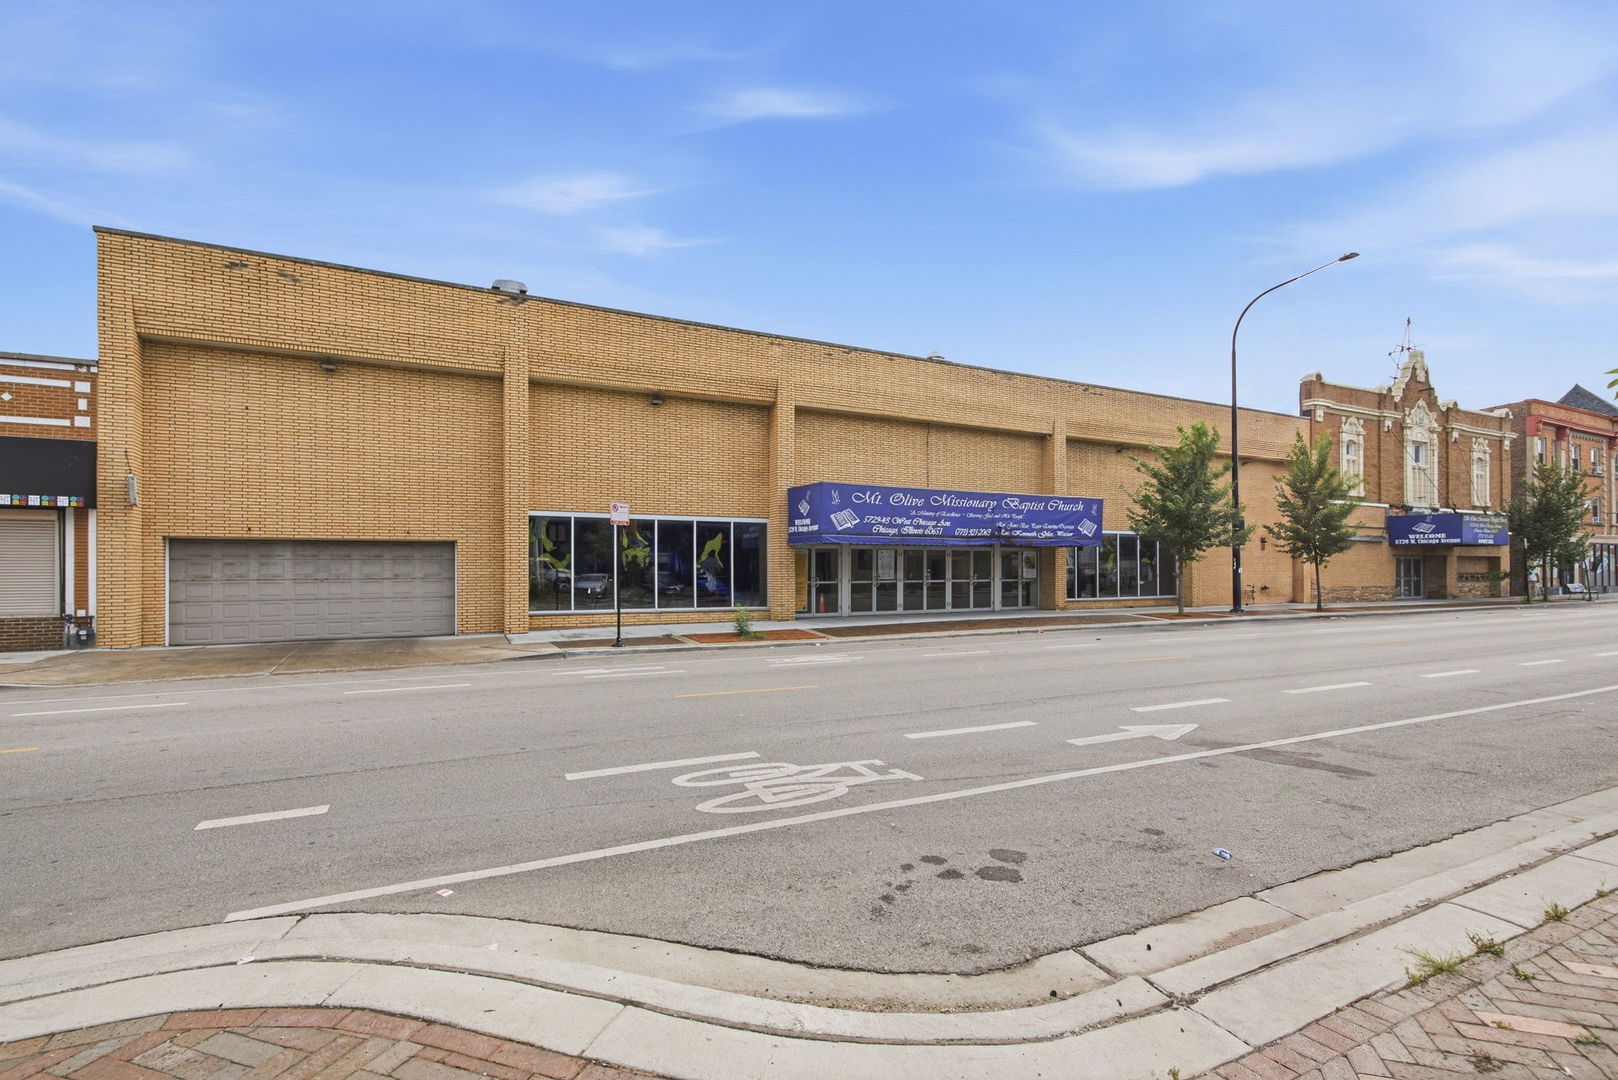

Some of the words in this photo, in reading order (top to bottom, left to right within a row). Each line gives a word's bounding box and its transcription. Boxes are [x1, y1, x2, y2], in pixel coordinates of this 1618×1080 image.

[852, 490, 883, 505] Mt.
[889, 492, 925, 507] Olive
[930, 493, 997, 512] Missionary
[1001, 496, 1045, 513] Baptist
[1047, 499, 1084, 512] Church
[891, 516, 912, 525] West
[912, 517, 937, 526] Chicago
[900, 525, 924, 535] Illinois
[924, 525, 944, 535] 60651
